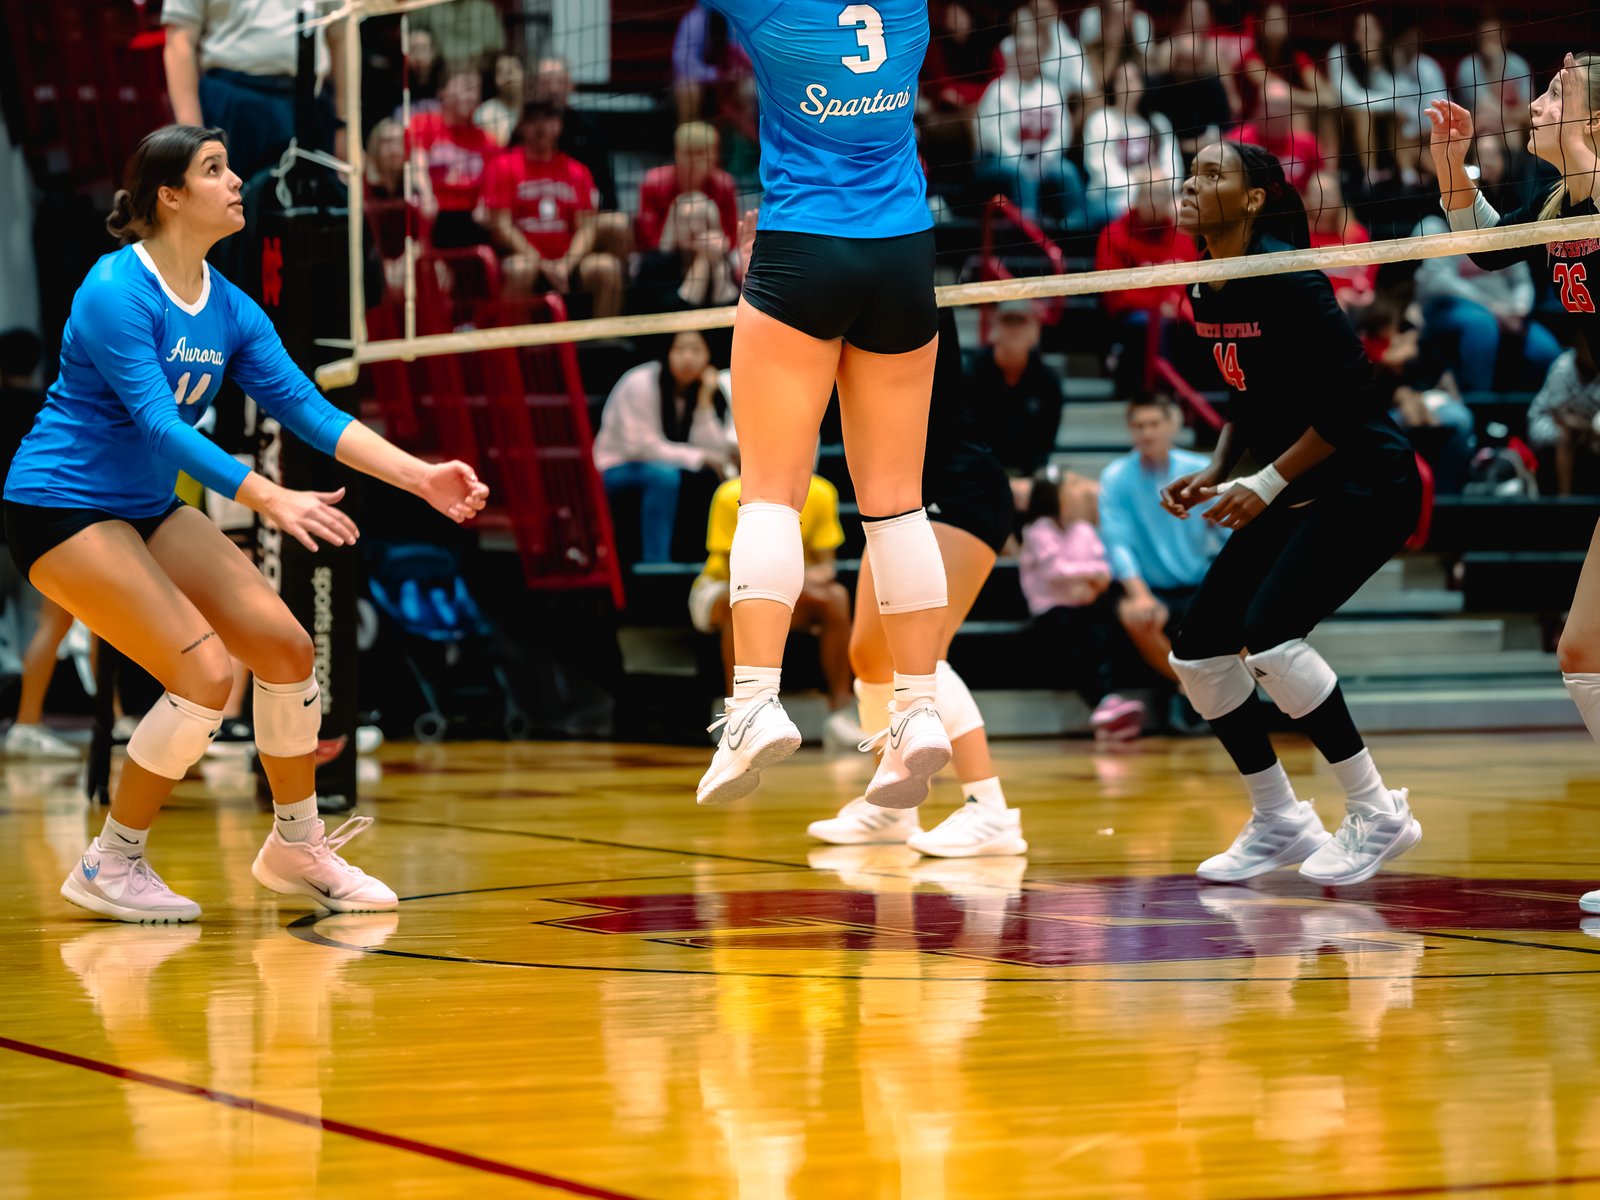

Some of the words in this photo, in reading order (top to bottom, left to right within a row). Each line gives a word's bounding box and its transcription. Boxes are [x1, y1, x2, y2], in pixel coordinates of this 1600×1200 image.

[838, 4, 888, 74] 3
[799, 83, 911, 124] Spartans
[1553, 262, 1596, 313] 26
[166, 336, 224, 366] Aurora
[1213, 342, 1247, 391] 14
[311, 566, 333, 633] sports
